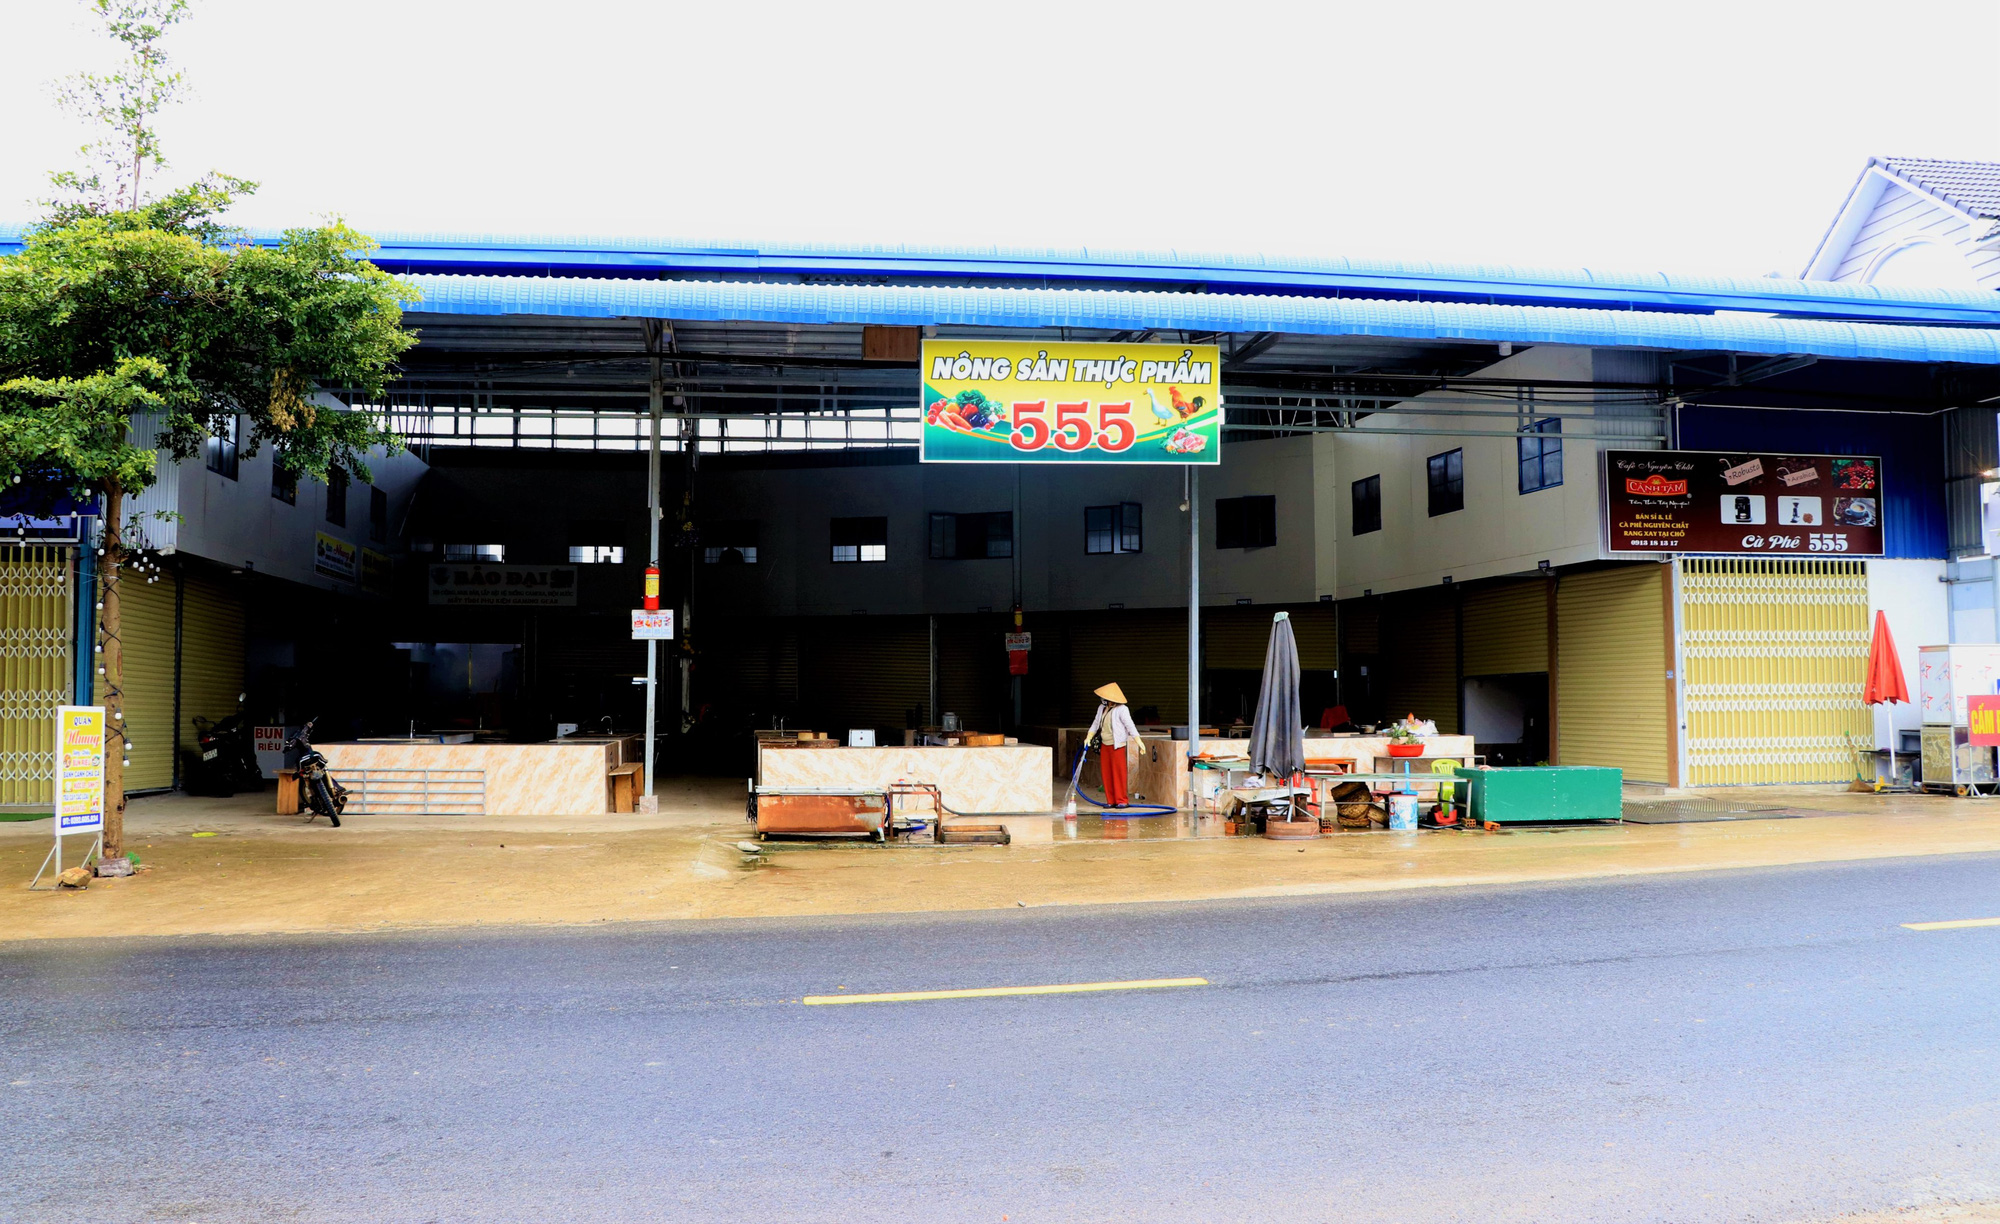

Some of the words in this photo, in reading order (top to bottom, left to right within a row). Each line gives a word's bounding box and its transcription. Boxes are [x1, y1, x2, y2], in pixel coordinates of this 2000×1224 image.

[931, 351, 1012, 381] NÔNG
[1015, 350, 1069, 382] SẢN
[1073, 355, 1138, 389] THỰC
[1139, 349, 1212, 384] PHẨM
[1009, 399, 1136, 452] 555
[1731, 463, 1761, 480] Robusta
[1791, 470, 1816, 482] Arabica
[1619, 520, 1629, 528] CÀ
[1643, 521, 1671, 529] NGUYÊN
[1671, 520, 1690, 529] CHẤT
[1635, 512, 1650, 520] BÁN
[1669, 529, 1686, 537] CHỖ
[1741, 534, 1765, 549] Cà
[1768, 534, 1802, 549] Phê
[1808, 532, 1849, 552] 555
[454, 565, 501, 585] BẢO
[506, 571, 548, 588] ĐẠI
[1971, 702, 1995, 735] CẤM
